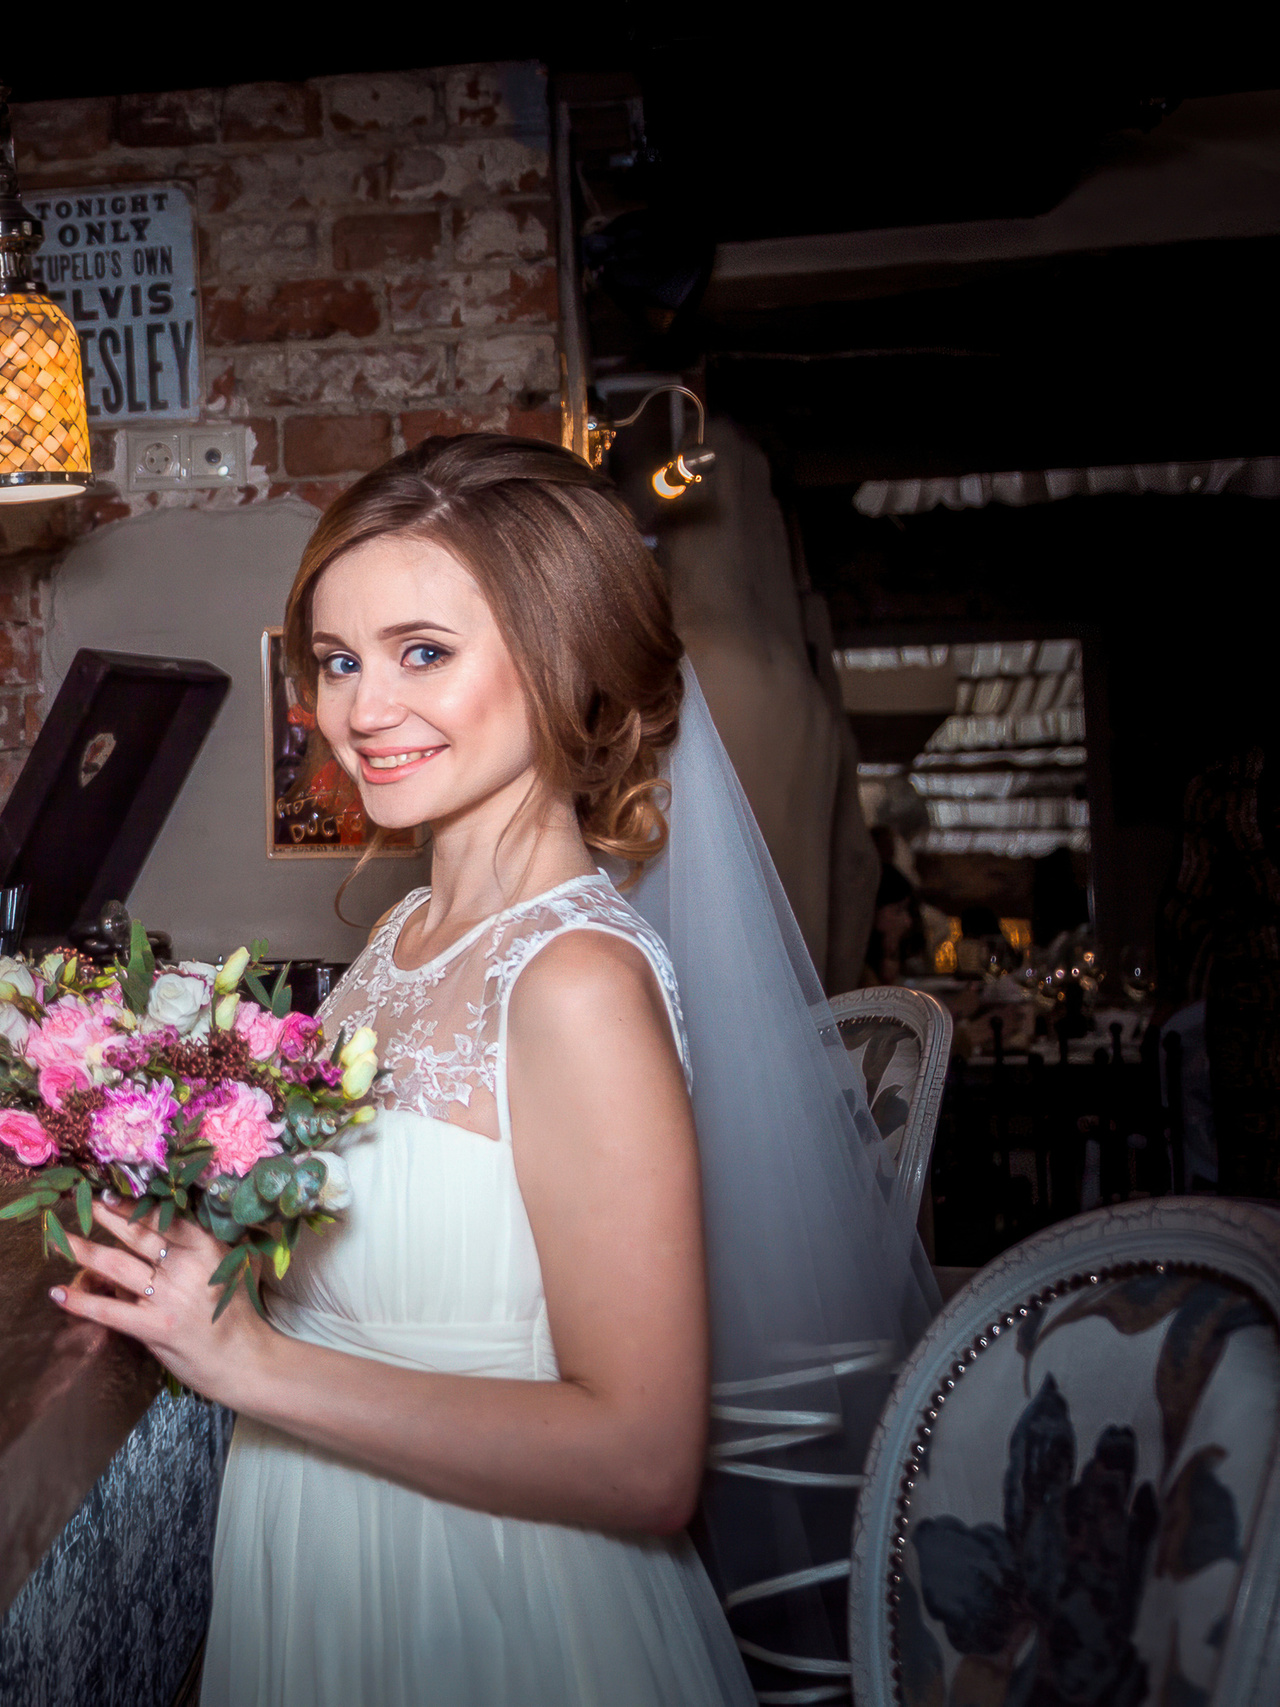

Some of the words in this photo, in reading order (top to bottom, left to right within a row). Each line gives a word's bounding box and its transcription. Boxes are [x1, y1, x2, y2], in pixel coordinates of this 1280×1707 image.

[35, 193, 168, 220] TONIGHT
[58, 219, 151, 247] ONLY
[35, 251, 122, 282] TUPELO'S
[133, 246, 173, 276] OWN
